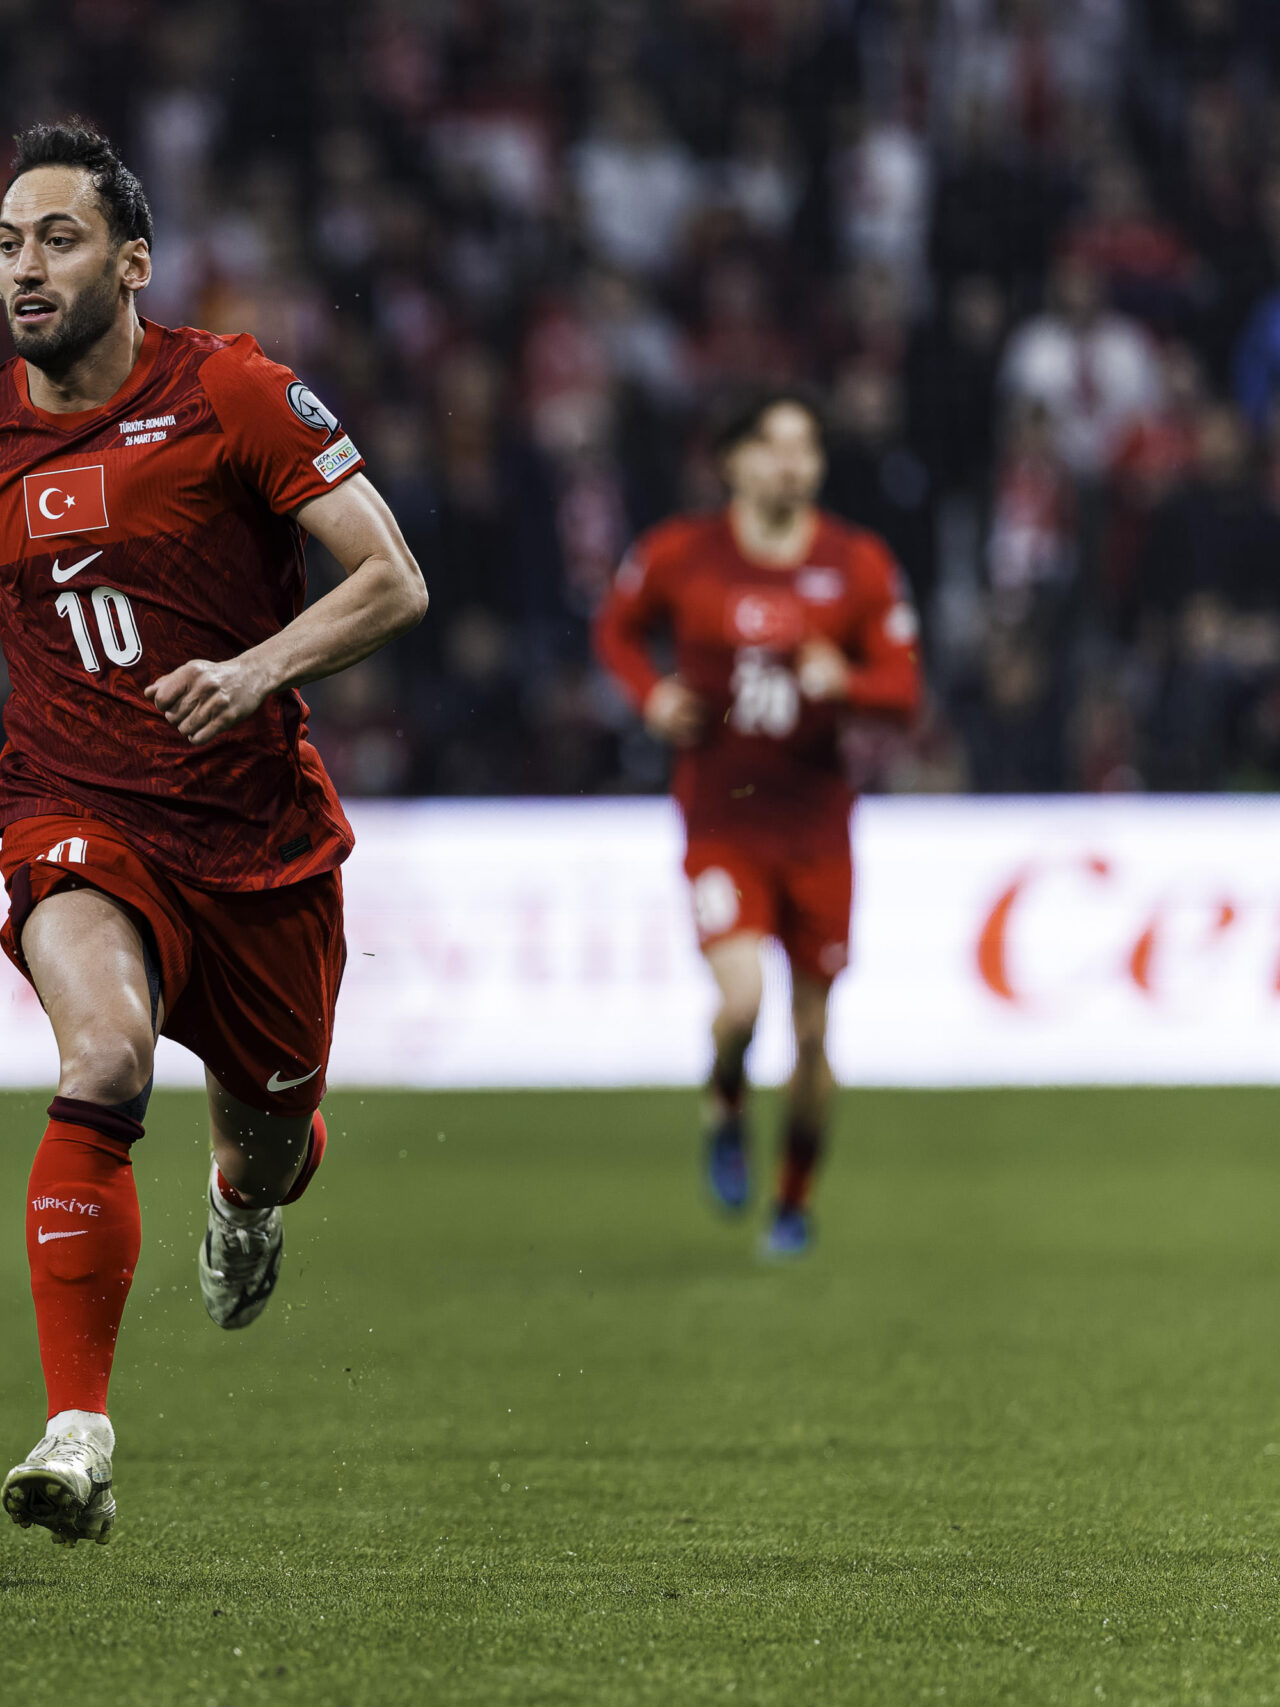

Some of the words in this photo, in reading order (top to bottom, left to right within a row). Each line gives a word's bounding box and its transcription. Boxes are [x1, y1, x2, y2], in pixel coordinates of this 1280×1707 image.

[119, 415, 176, 433] TÜRKİYE-ROMANYA
[125, 436, 133, 446] 26
[134, 433, 151, 444] MART
[152, 431, 167, 442] 2026
[315, 453, 330, 467] UEFA
[320, 446, 355, 474] FOUND
[55, 586, 142, 673] 10
[32, 1196, 101, 1217] TÜRKİYE
